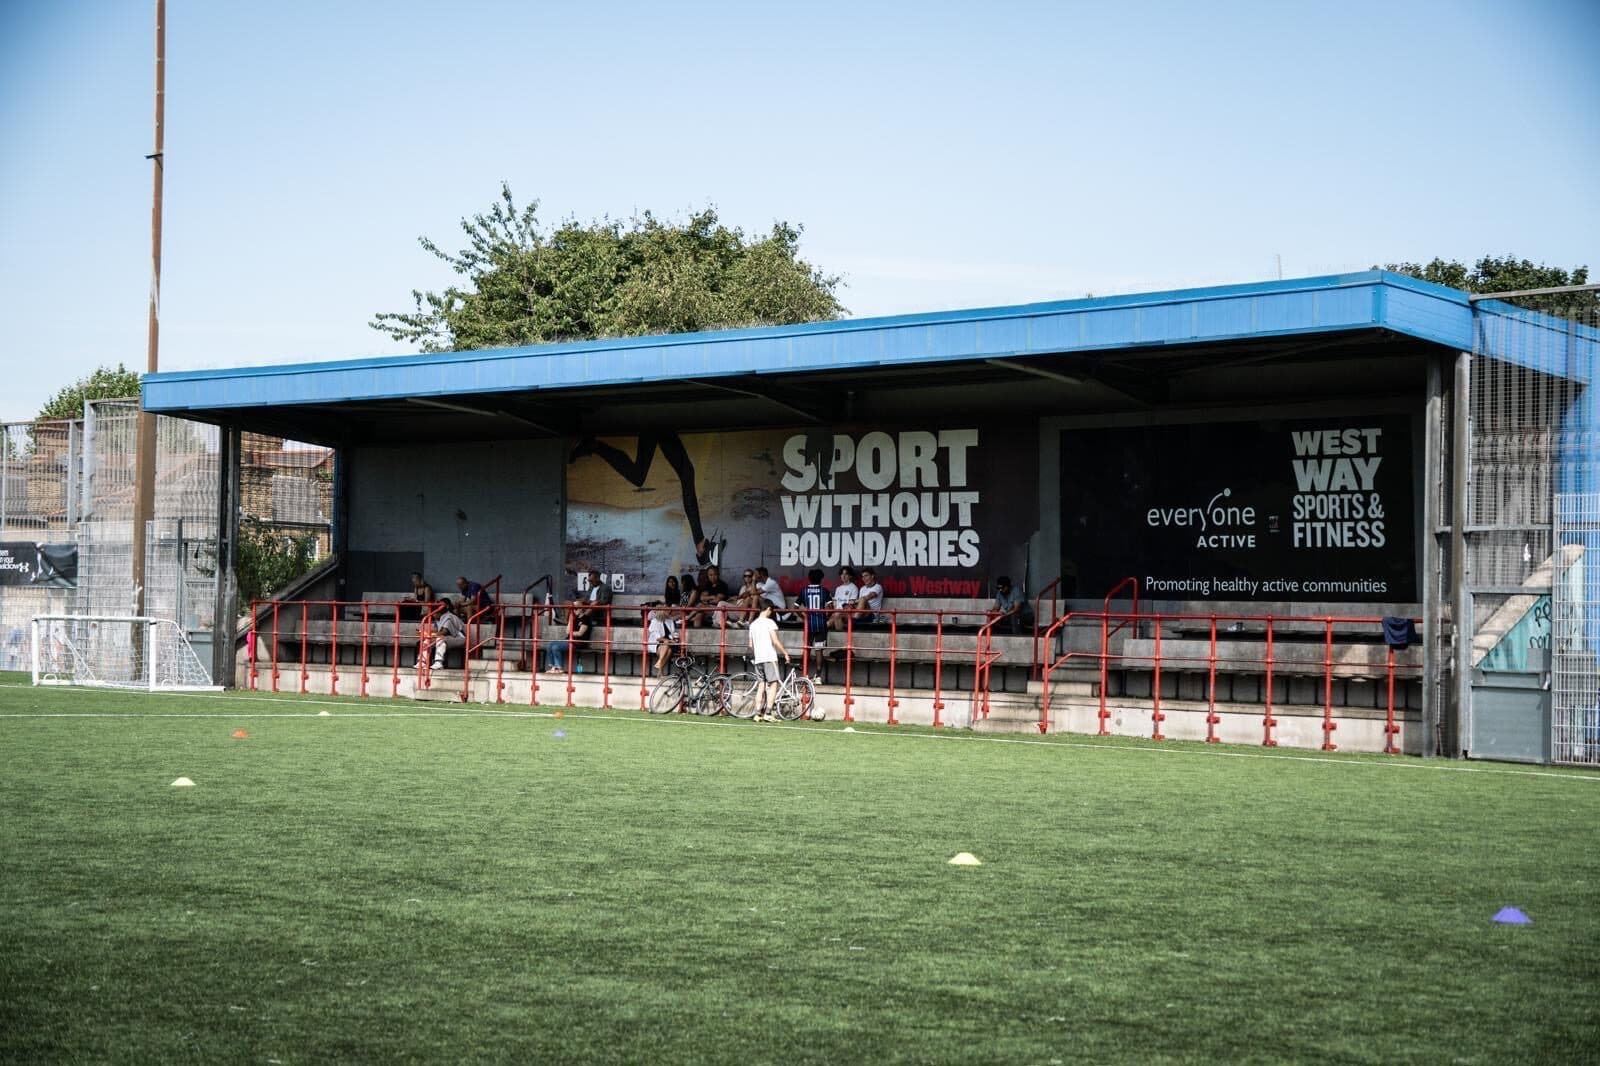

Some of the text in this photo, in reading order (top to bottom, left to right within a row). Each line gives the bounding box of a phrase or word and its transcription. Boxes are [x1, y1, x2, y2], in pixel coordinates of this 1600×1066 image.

[1292, 428, 1382, 456] WEST
[781, 429, 979, 492] SPORT
[1292, 457, 1383, 492] WAY
[781, 491, 979, 528] WITHOUT
[1147, 487, 1256, 532] everyone
[1293, 493, 1385, 520] SPORTS &
[780, 529, 980, 567] BOUNDARIES
[1196, 535, 1256, 548] ACTIVE
[1293, 520, 1386, 548] FITNESS
[910, 576, 981, 598] Westway
[1146, 576, 1387, 596] Promoting healthy active communities
[808, 594, 820, 610] 10
